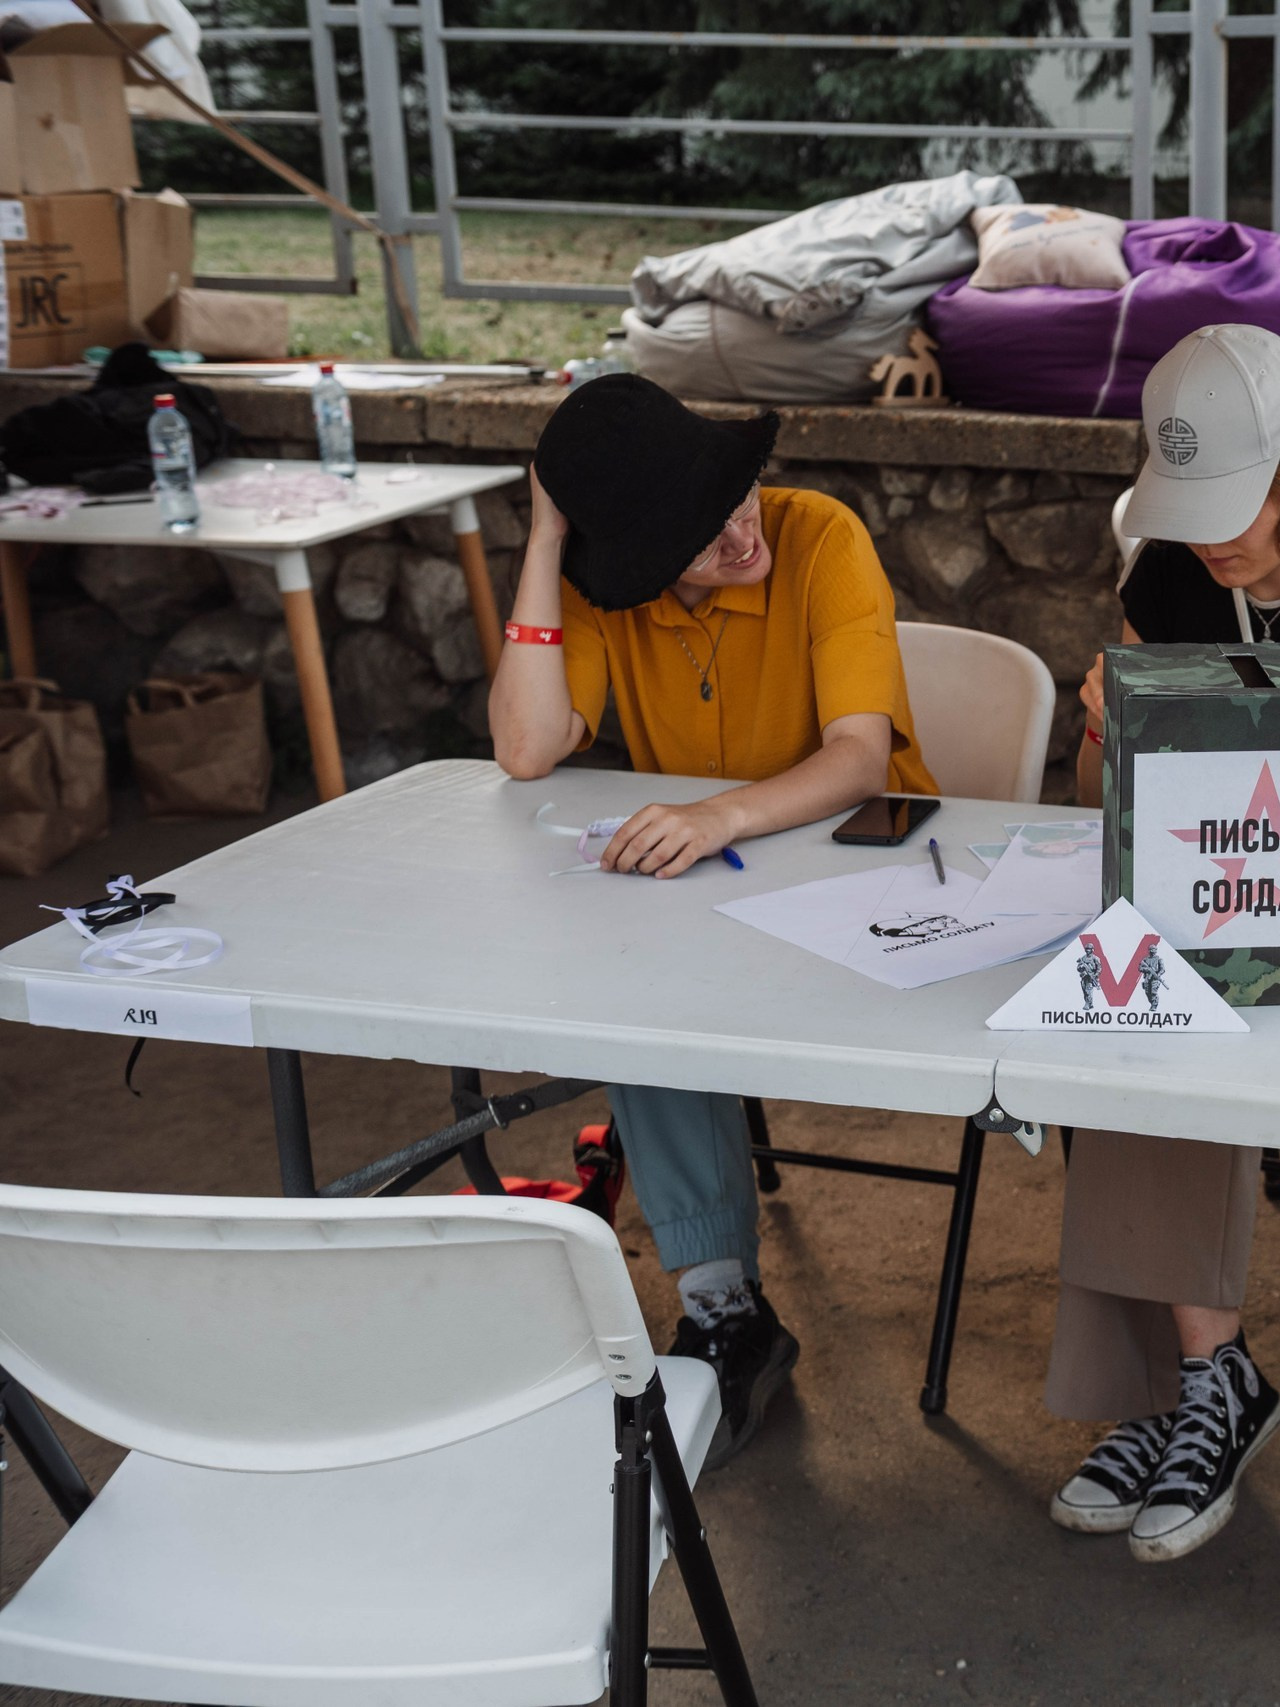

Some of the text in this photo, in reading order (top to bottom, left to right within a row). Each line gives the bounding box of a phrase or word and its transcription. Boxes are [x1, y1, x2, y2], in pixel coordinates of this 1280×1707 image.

[16, 273, 73, 328] JRC
[883, 921, 995, 953] ПИСЬМО СОЛДАТУ
[1041, 1011, 1193, 1028] ПИСЬМО СОЛДАТУ
